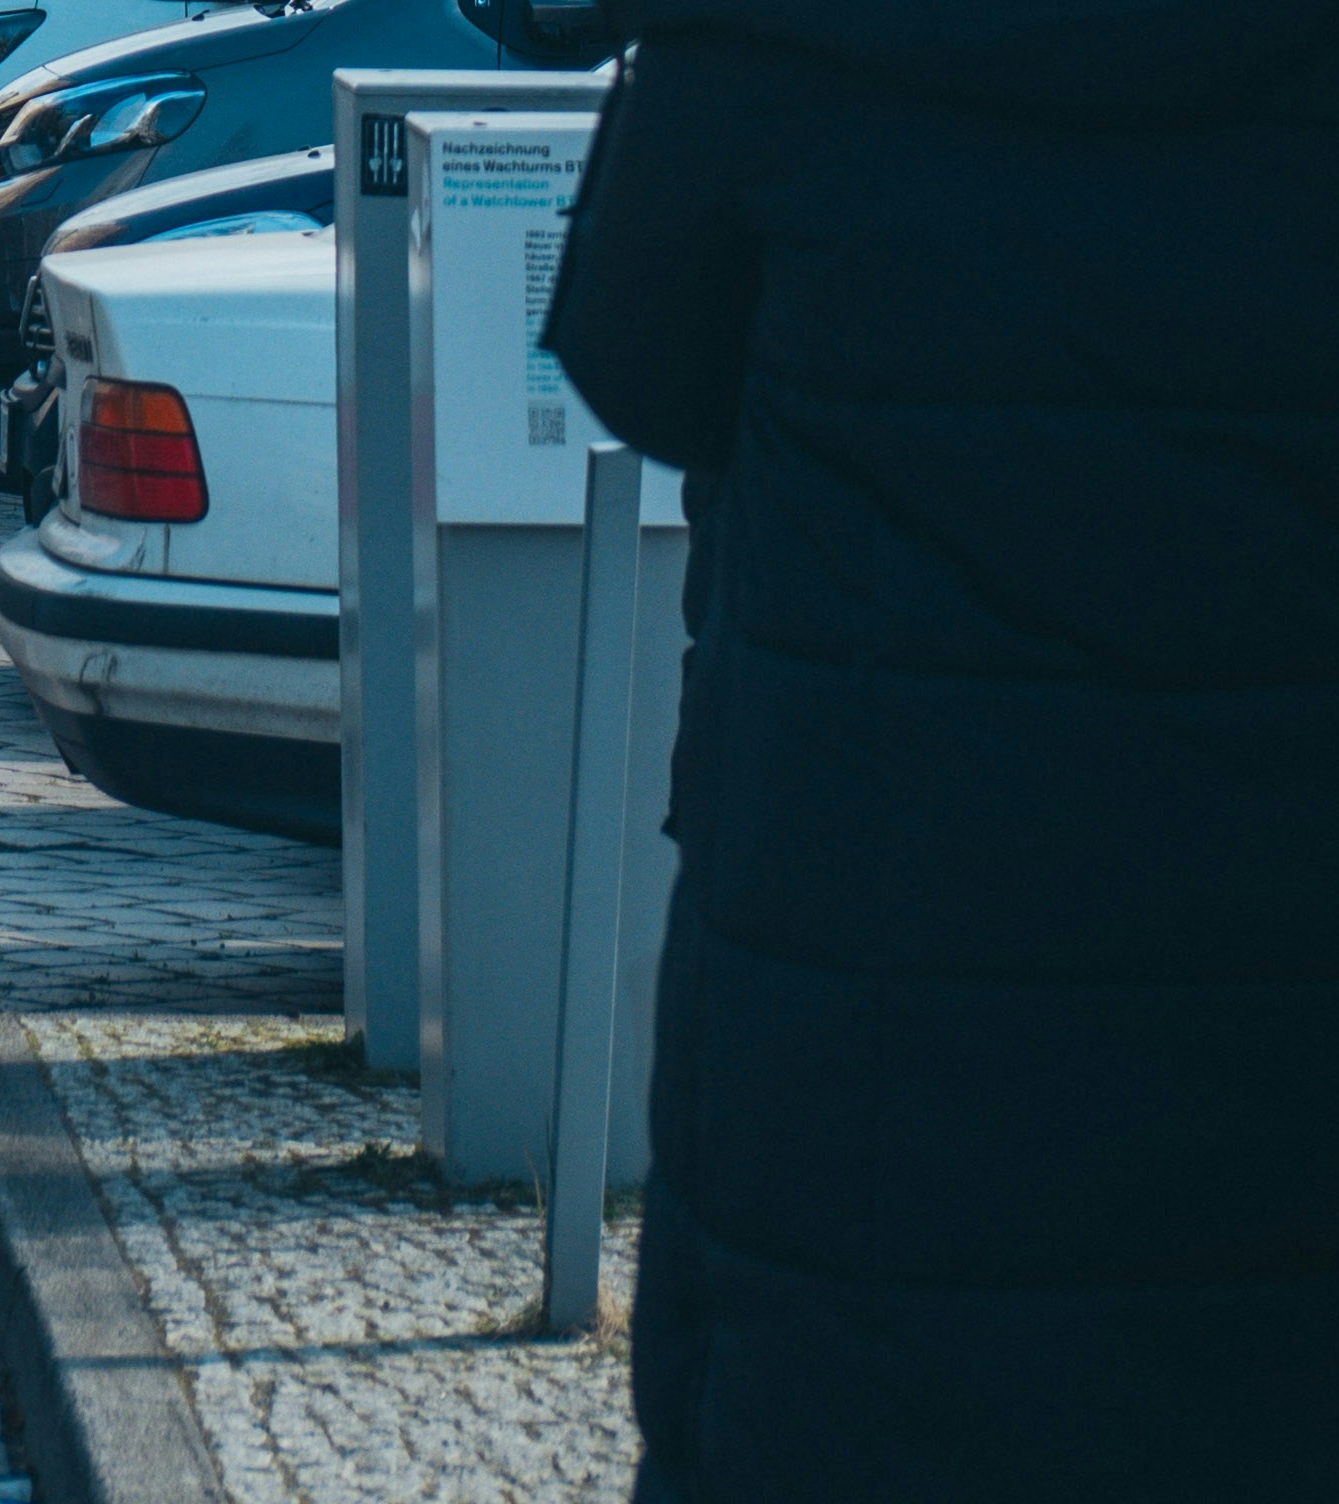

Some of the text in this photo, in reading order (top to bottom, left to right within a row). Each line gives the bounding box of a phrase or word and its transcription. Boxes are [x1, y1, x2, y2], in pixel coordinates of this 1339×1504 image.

[442, 141, 550, 157] Nachzeichnung
[442, 161, 480, 172] eines
[483, 159, 561, 172] Wachturms
[443, 176, 549, 190] Representation
[443, 194, 457, 206] of
[460, 197, 468, 206] a
[472, 194, 552, 206] Watchtower
